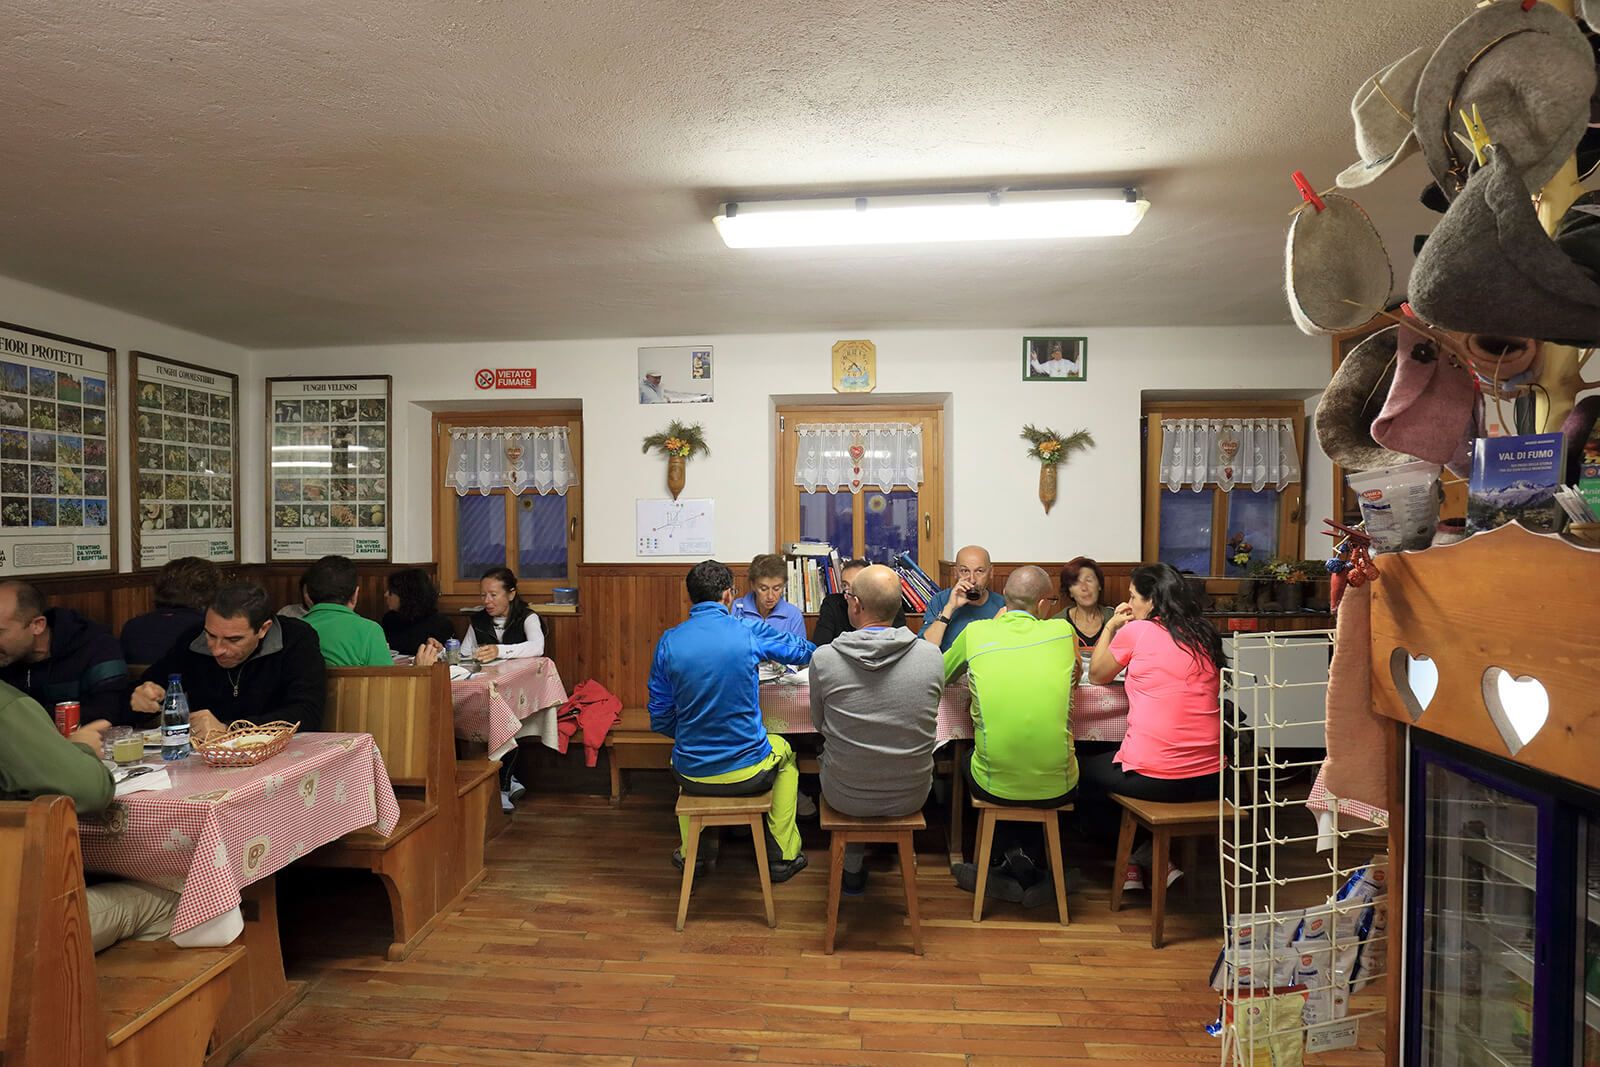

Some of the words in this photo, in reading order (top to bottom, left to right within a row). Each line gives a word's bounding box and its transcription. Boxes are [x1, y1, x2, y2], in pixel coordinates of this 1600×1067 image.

[0, 336, 28, 355] FIORI
[31, 343, 83, 366] PROTETTI
[156, 365, 177, 377] FUNGHI
[178, 369, 215, 385] COMMESTIBILI
[498, 370, 532, 378] VIETATO
[498, 378, 531, 386] FUMARE
[303, 384, 326, 392] FUNGHI
[1498, 452, 1515, 461] VAL
[1516, 451, 1526, 460] DI
[1527, 449, 1553, 459] FUMO
